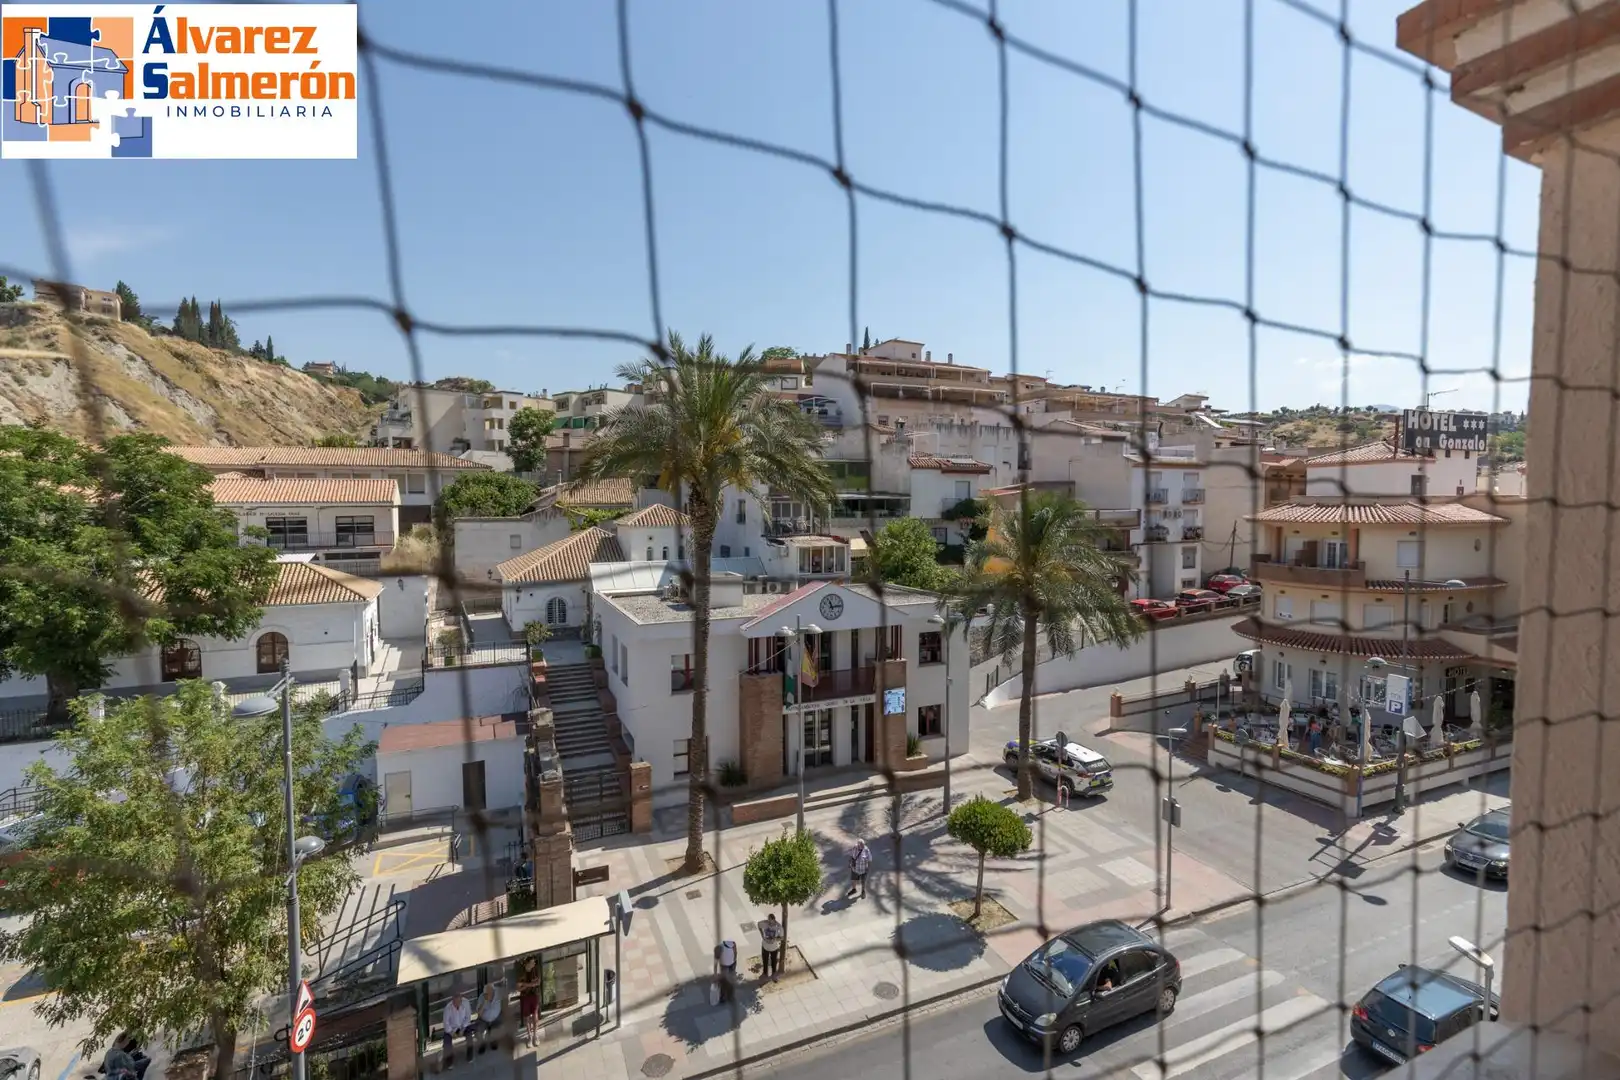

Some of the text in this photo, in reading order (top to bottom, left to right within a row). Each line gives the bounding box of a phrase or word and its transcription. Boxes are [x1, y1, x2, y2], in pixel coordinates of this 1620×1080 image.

[1407, 410, 1457, 432] HOTEL
[1439, 433, 1486, 451] Gonzalo
[297, 1019, 312, 1043] 20
